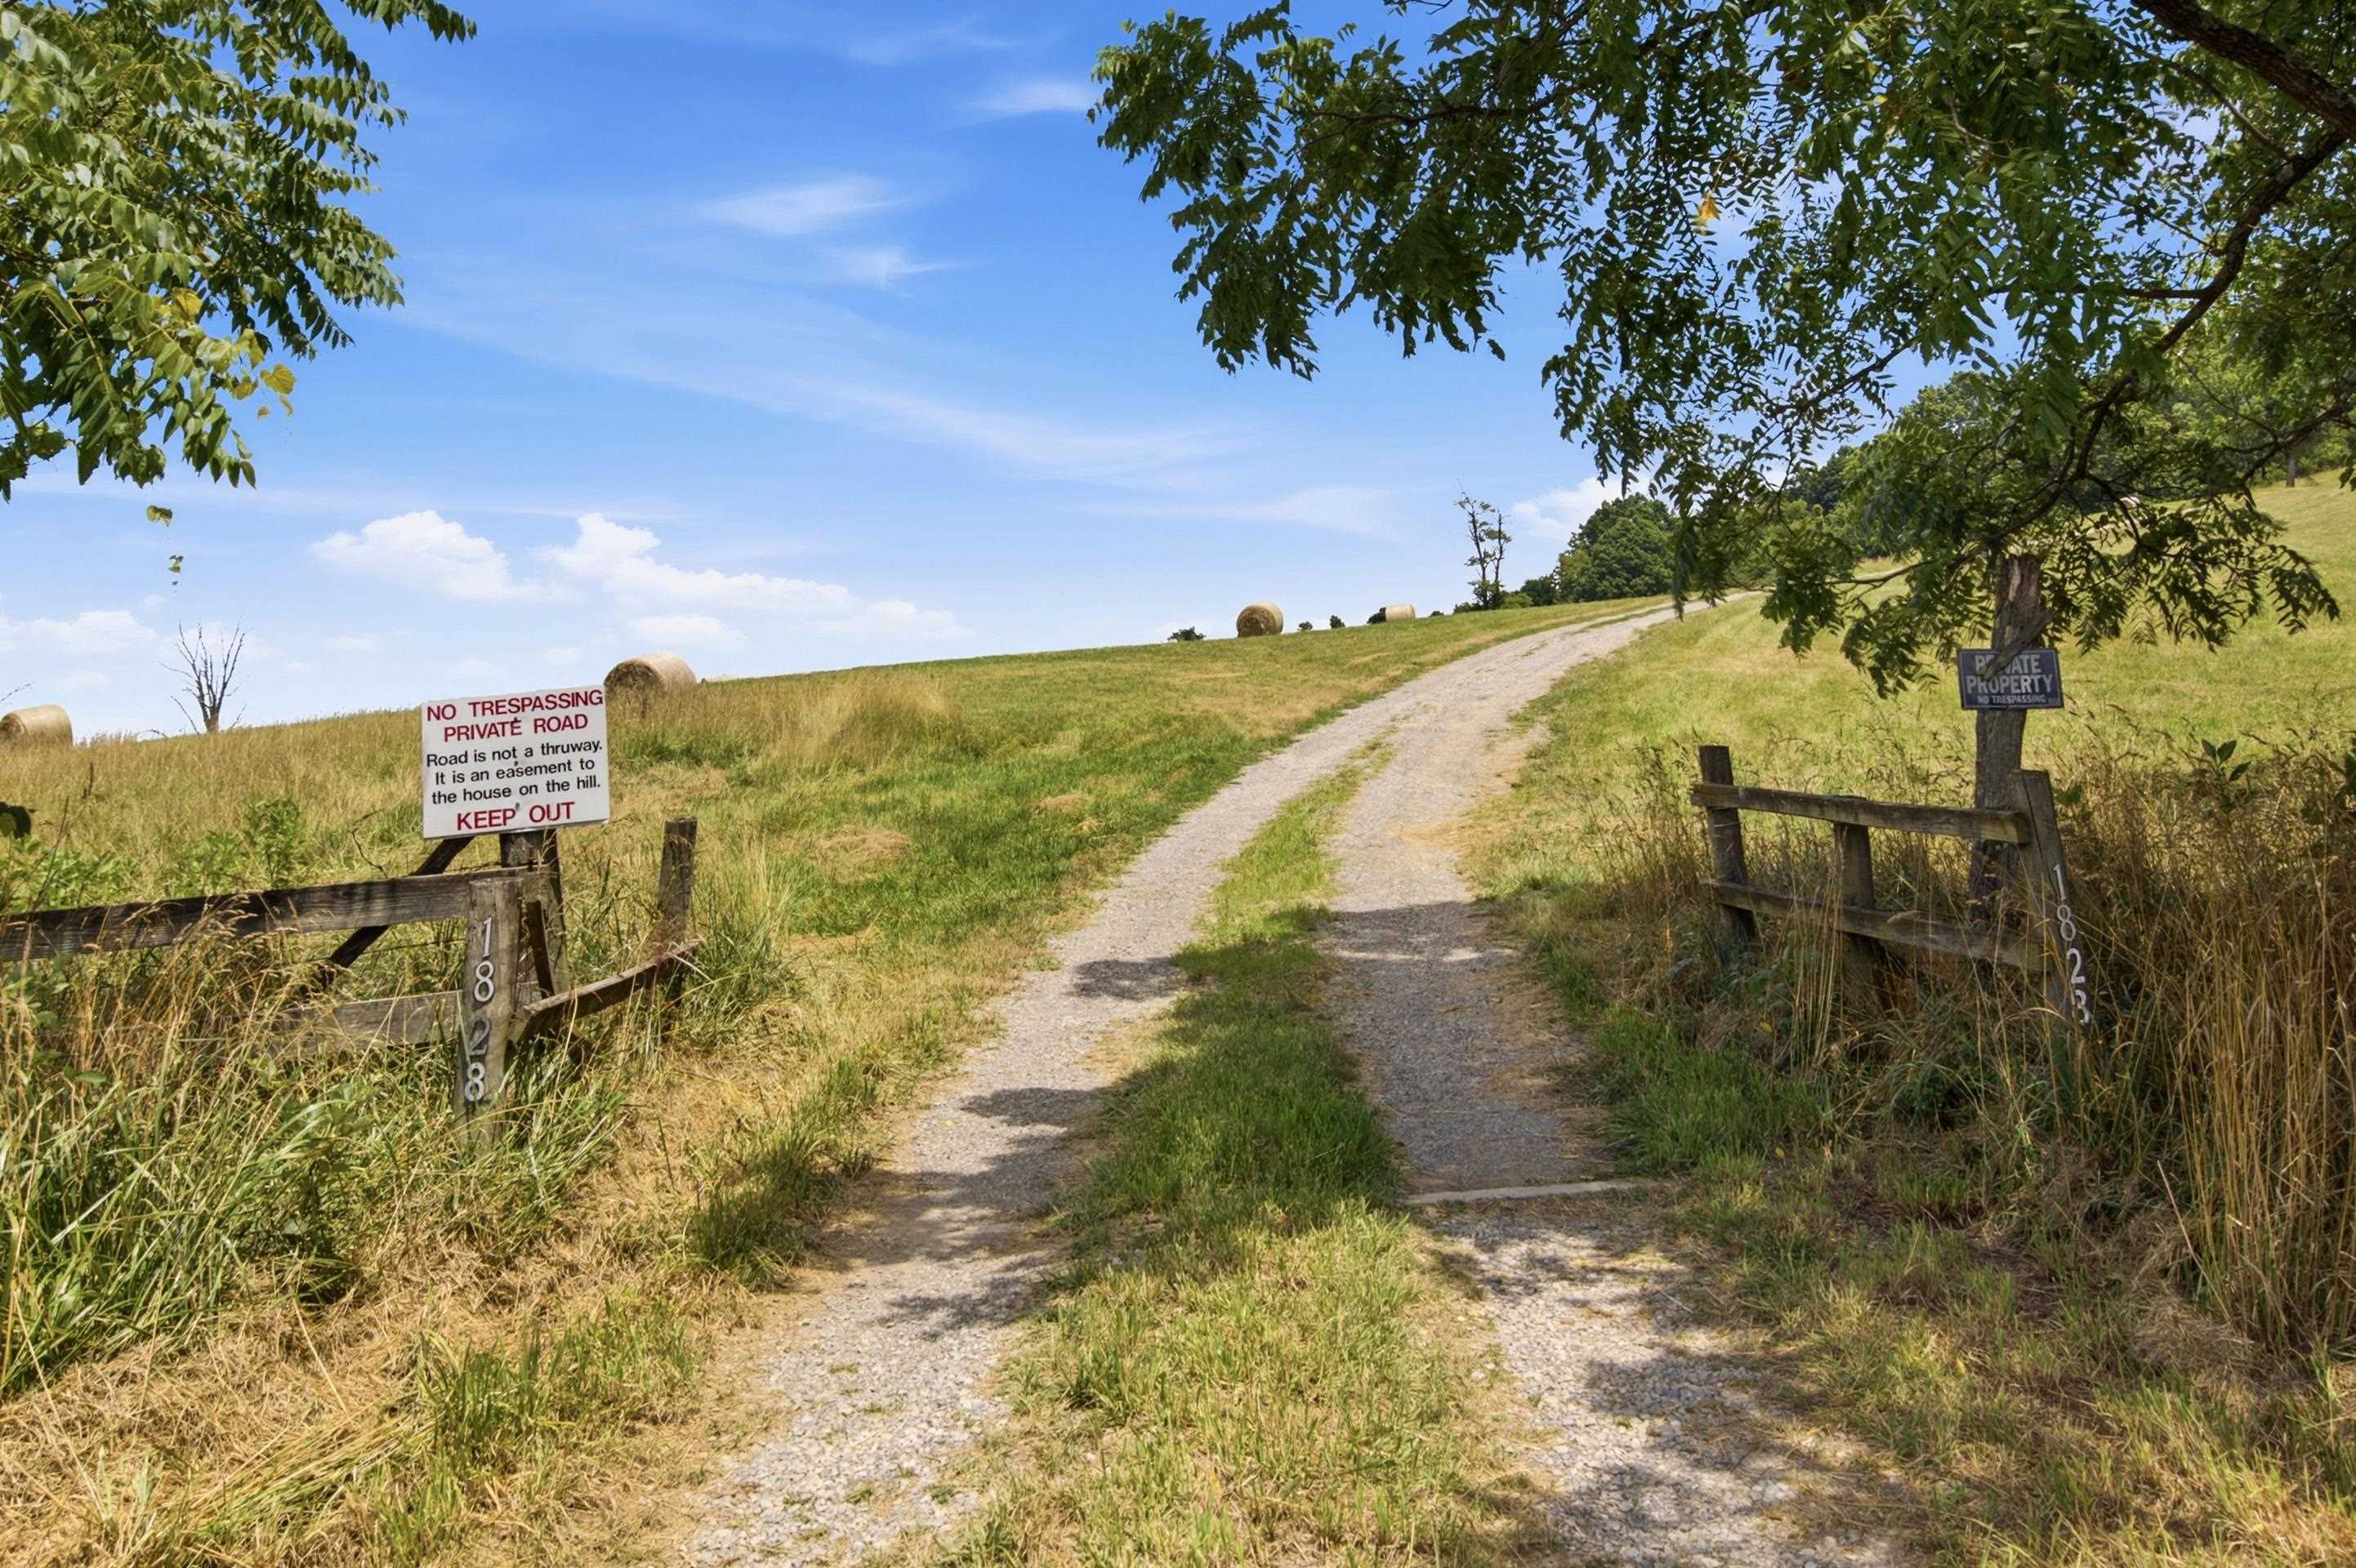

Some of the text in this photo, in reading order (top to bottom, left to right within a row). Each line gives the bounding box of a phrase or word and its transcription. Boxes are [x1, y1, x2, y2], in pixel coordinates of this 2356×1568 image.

[1966, 675, 2053, 693] PROPERTY
[427, 690, 603, 721] NO TRESPASSING
[1978, 695, 2046, 704] NO TRESPASSING
[444, 714, 588, 742] PRIVATE ROAD
[426, 741, 603, 767] Road is not a thruway.
[435, 758, 595, 785] It is an easement to
[431, 775, 600, 804] the house on the hill.
[457, 802, 575, 831] KEEP OUT
[464, 916, 494, 1102] 1828
